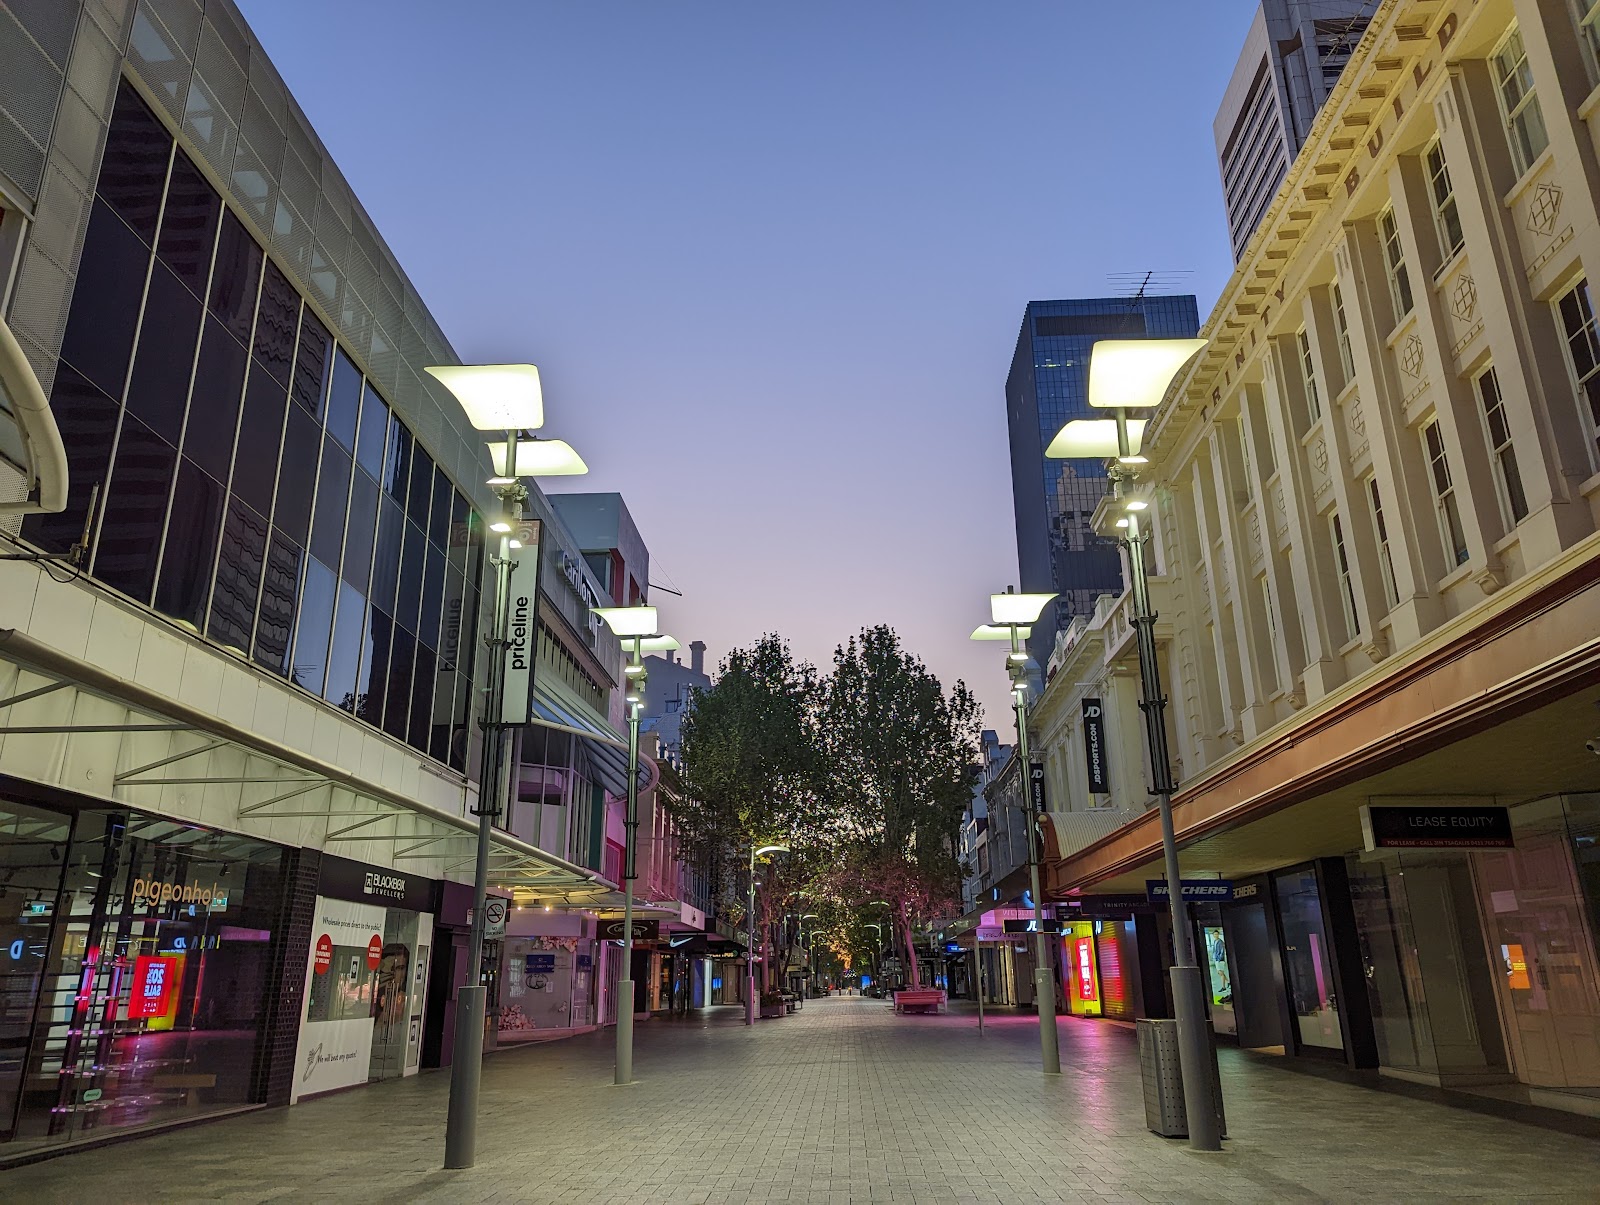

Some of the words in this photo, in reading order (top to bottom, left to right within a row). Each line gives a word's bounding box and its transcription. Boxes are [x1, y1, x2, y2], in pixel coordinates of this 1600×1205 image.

[1200, 278, 1287, 423] TRINITY
[1344, 0, 1478, 200] BUILD
[511, 596, 529, 670] priceline
[1084, 706, 1101, 718] JD
[1089, 723, 1102, 785] JDSPORTS.COM
[1031, 769, 1044, 779] JD
[1408, 816, 1448, 827] LEASE
[1450, 816, 1494, 828] EQUITY
[131, 872, 225, 907] pigeonhole
[372, 873, 406, 892] BLACKBOX
[1152, 886, 1228, 895] SKCHERS
